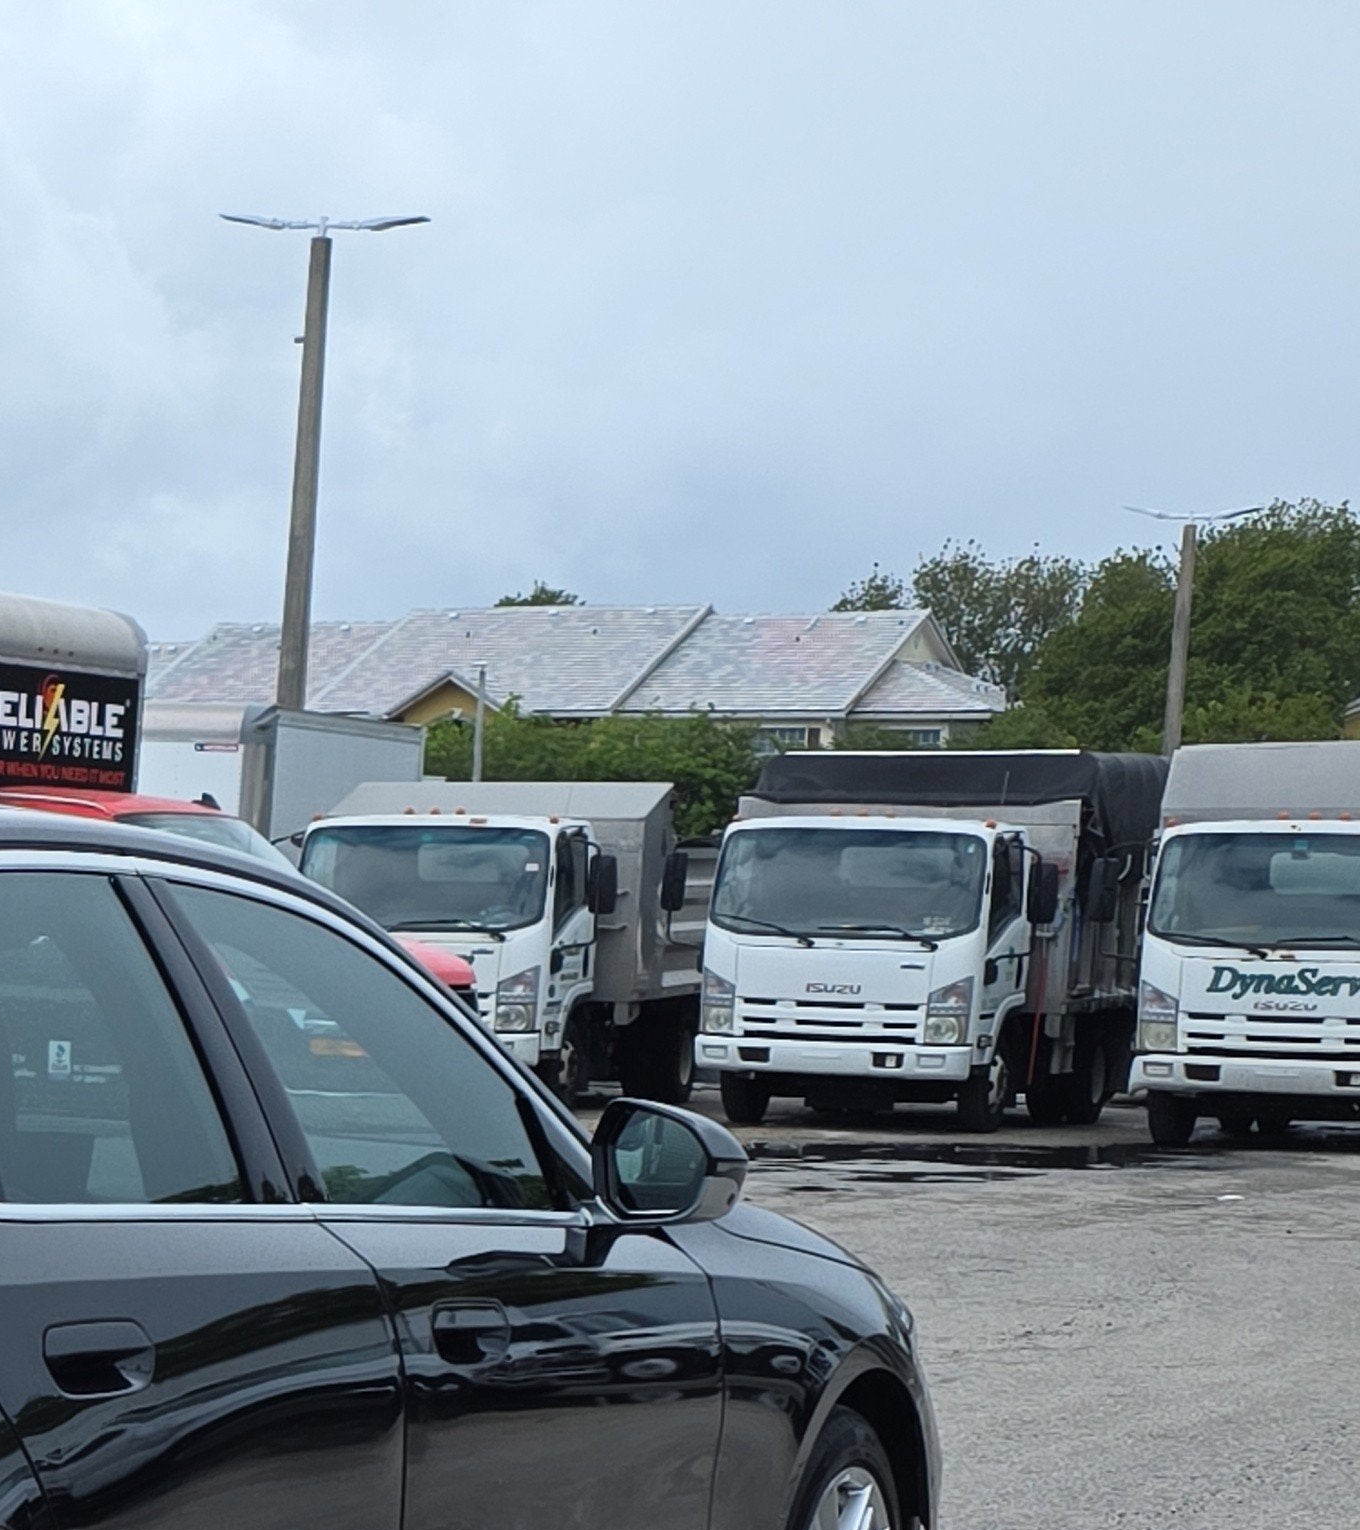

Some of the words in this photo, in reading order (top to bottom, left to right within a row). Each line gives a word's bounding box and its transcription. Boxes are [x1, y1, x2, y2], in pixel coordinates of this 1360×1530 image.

[52, 735, 124, 762] SYSTEMS
[40, 764, 60, 780] YOU
[806, 982, 862, 995] ISUZU
[1253, 1000, 1318, 1012] ISUZU
